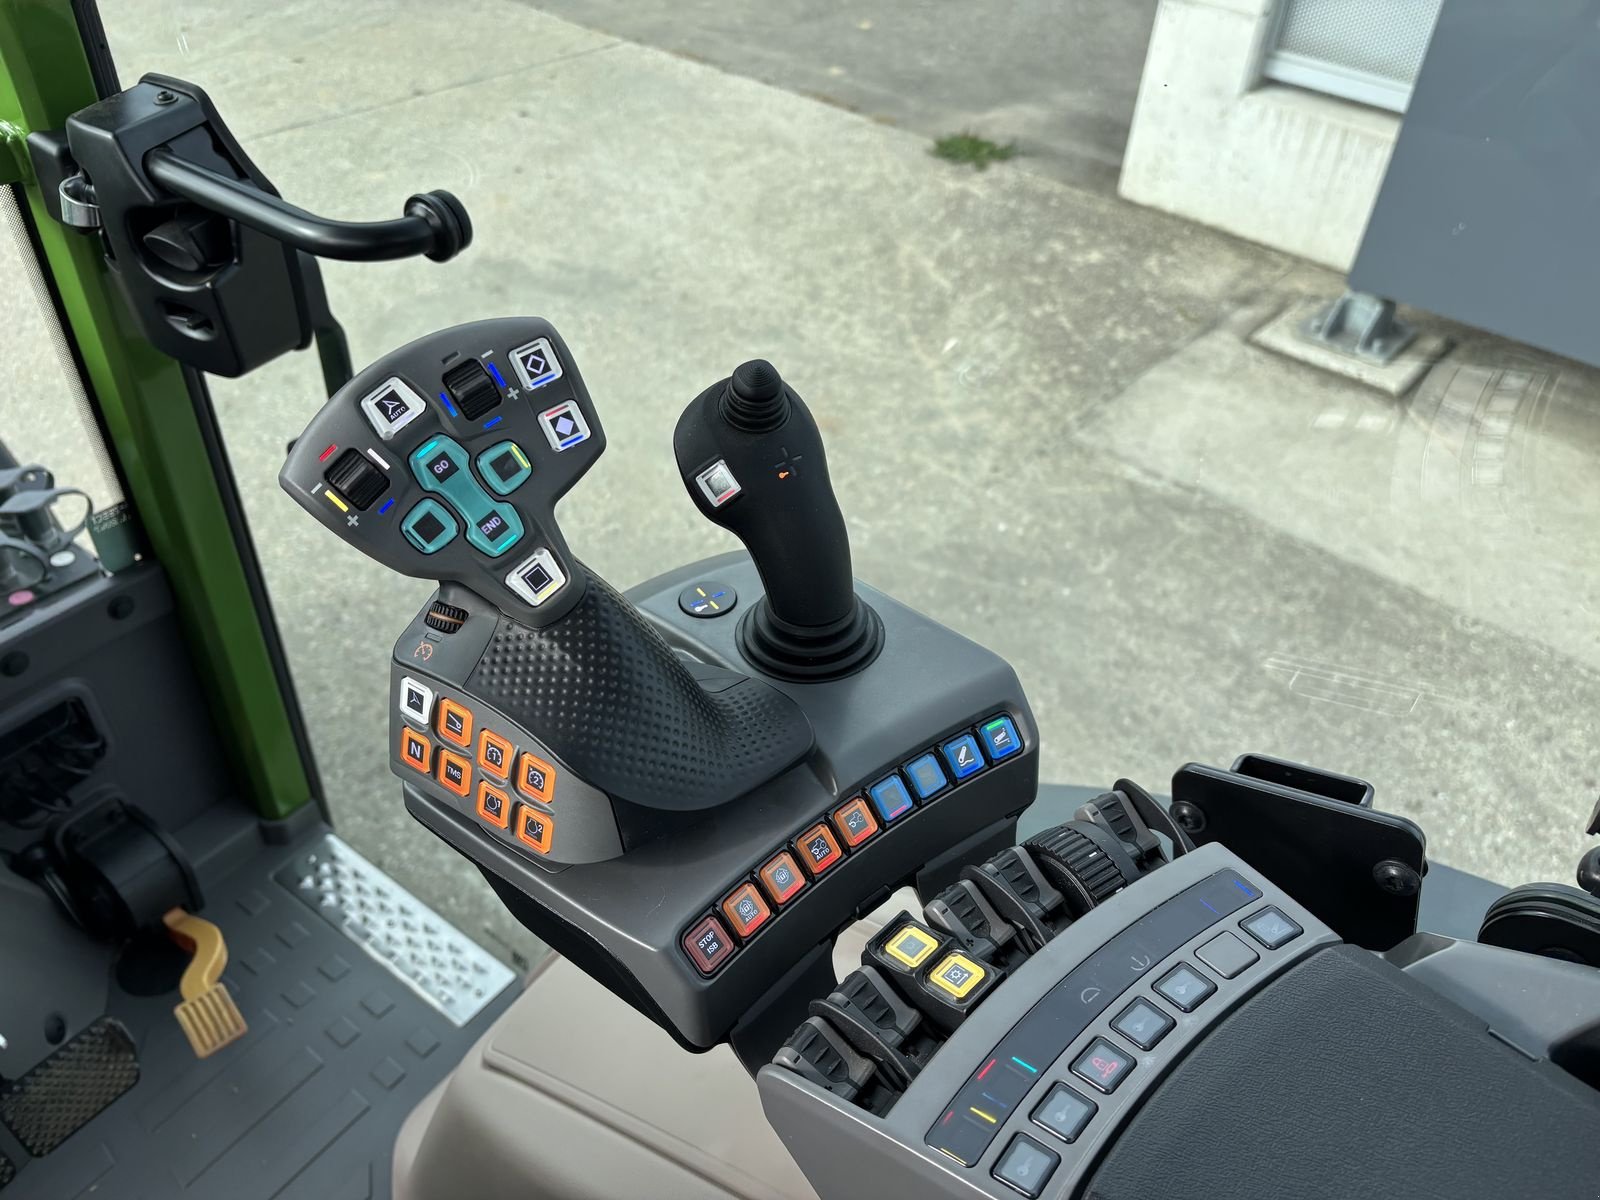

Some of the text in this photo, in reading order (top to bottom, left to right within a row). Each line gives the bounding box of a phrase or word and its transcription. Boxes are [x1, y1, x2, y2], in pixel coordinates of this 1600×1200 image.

[390, 406, 406, 420] AUTO
[434, 460, 449, 473] GO
[481, 516, 502, 535] END
[410, 741, 421, 758] N
[447, 766, 461, 780] TMS
[816, 848, 830, 860] AUTO
[745, 909, 758, 922] AUTO
[698, 931, 715, 949] STOP
[706, 941, 719, 954] ISB
